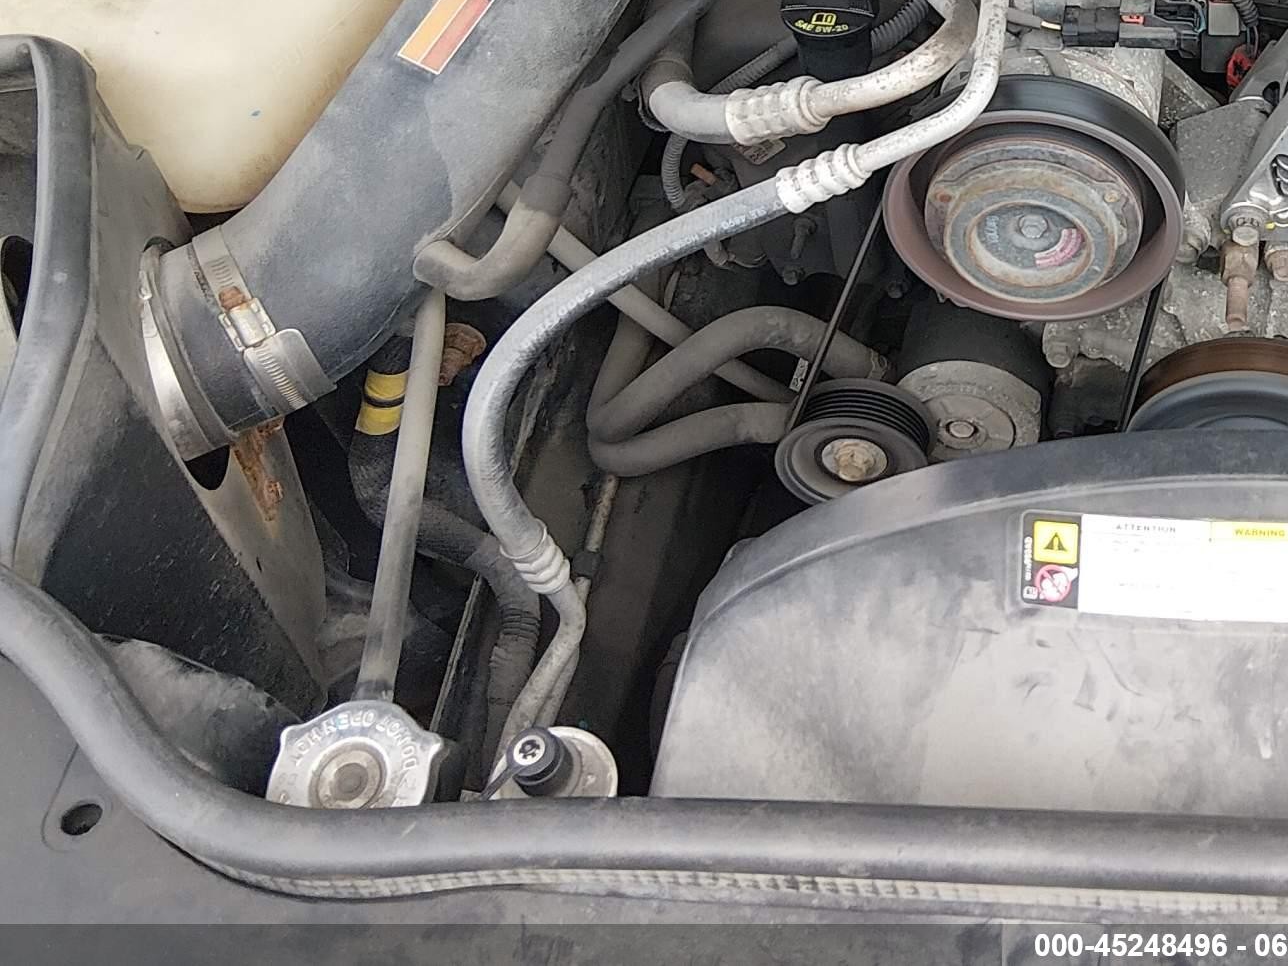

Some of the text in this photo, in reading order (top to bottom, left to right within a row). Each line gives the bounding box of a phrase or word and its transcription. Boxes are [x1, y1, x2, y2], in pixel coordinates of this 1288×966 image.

[795, 20, 849, 33] SAE 5W-20
[1234, 528, 1286, 537] WARNING
